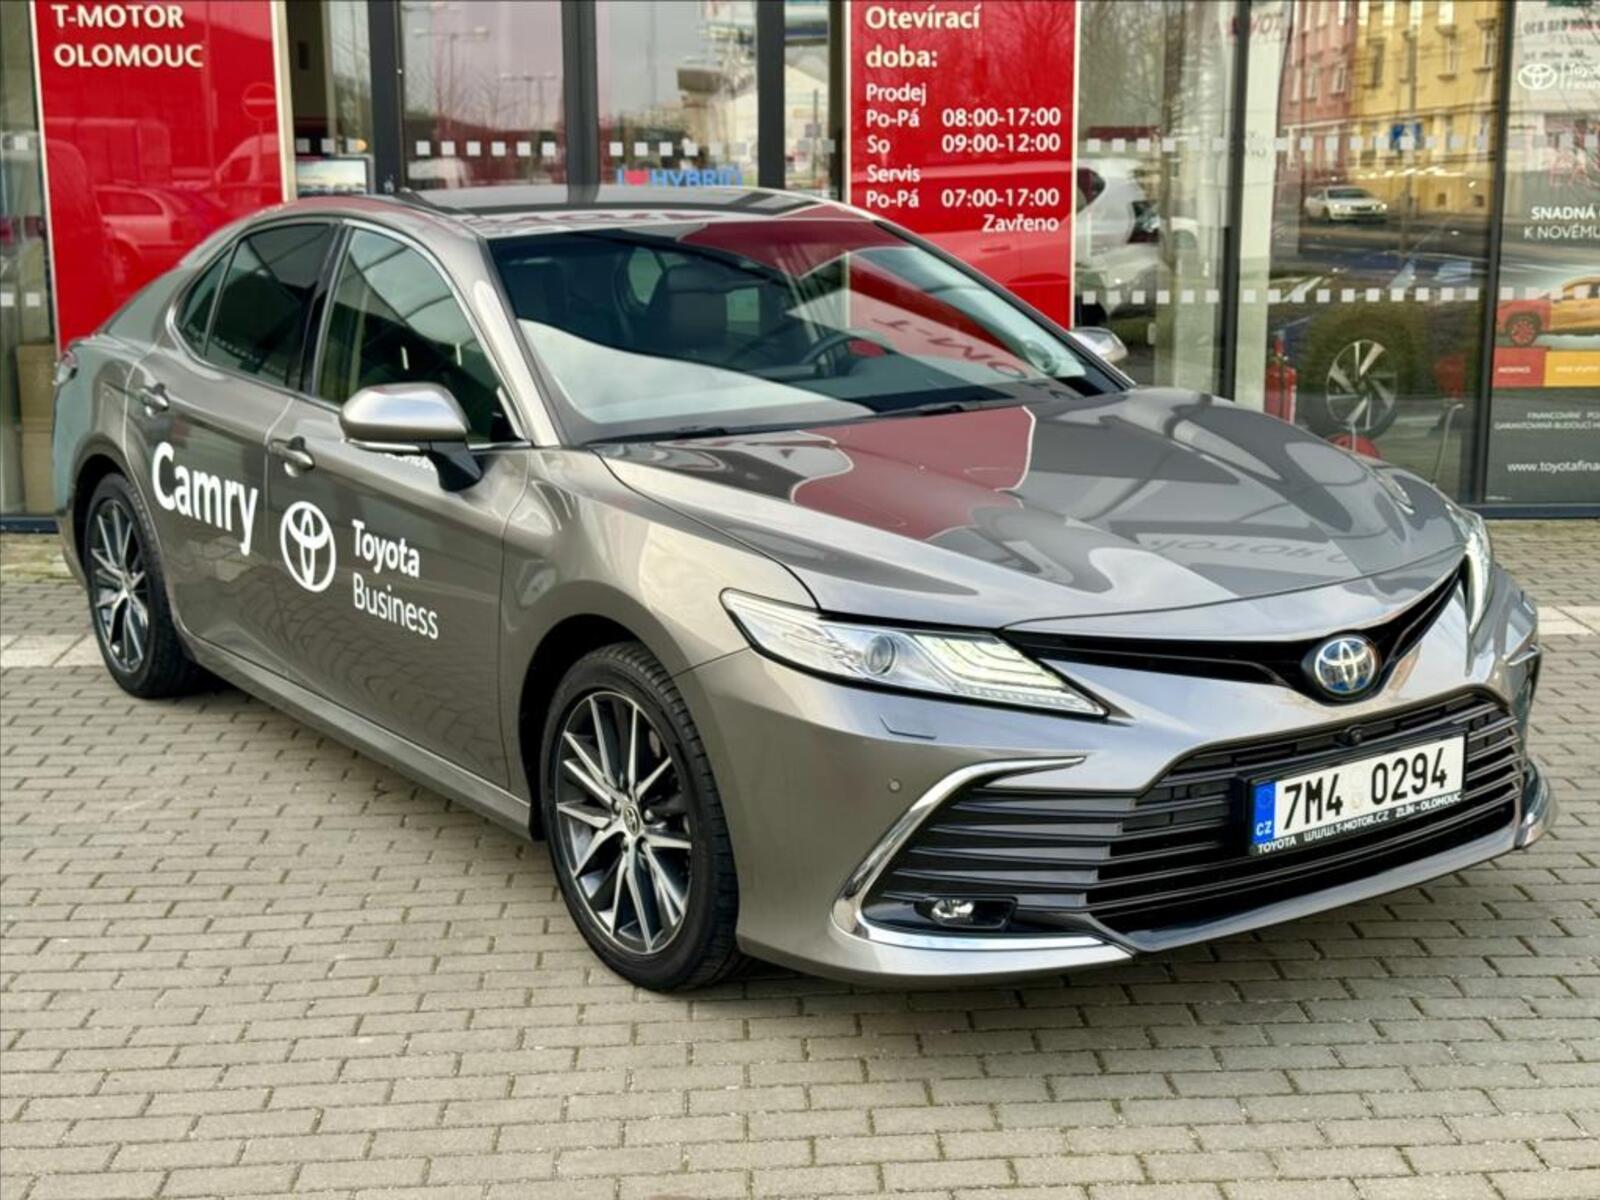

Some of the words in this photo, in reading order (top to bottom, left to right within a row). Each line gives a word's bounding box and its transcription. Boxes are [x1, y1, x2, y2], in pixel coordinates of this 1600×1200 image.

[51, 4, 184, 28] T-MOTOR
[865, 3, 982, 29] Otevírací
[53, 44, 204, 68] OLOMOUC
[865, 44, 938, 68] doba:
[866, 83, 926, 106] Prodej
[866, 108, 920, 128] Po-Pá
[941, 107, 1061, 127] 08:00-17:00
[867, 135, 891, 154] So
[941, 133, 1061, 153] 09:00-12:00
[867, 164, 921, 183] Servis
[866, 189, 919, 208] Po-Pá
[941, 188, 1060, 207] 07:00-17:00
[1530, 203, 1596, 220] SNADNÁ
[982, 213, 1060, 233] Zavřeno
[1524, 227, 1534, 239] K
[1507, 461, 1600, 473] www.toyotafina
[152, 442, 258, 556] Camry
[352, 519, 420, 578] Toyota
[353, 572, 439, 640] Business
[1283, 774, 1343, 830] 7M4
[1371, 748, 1447, 805] 0294
[1256, 821, 1272, 836] CZ
[1258, 836, 1297, 854] TOYOTA
